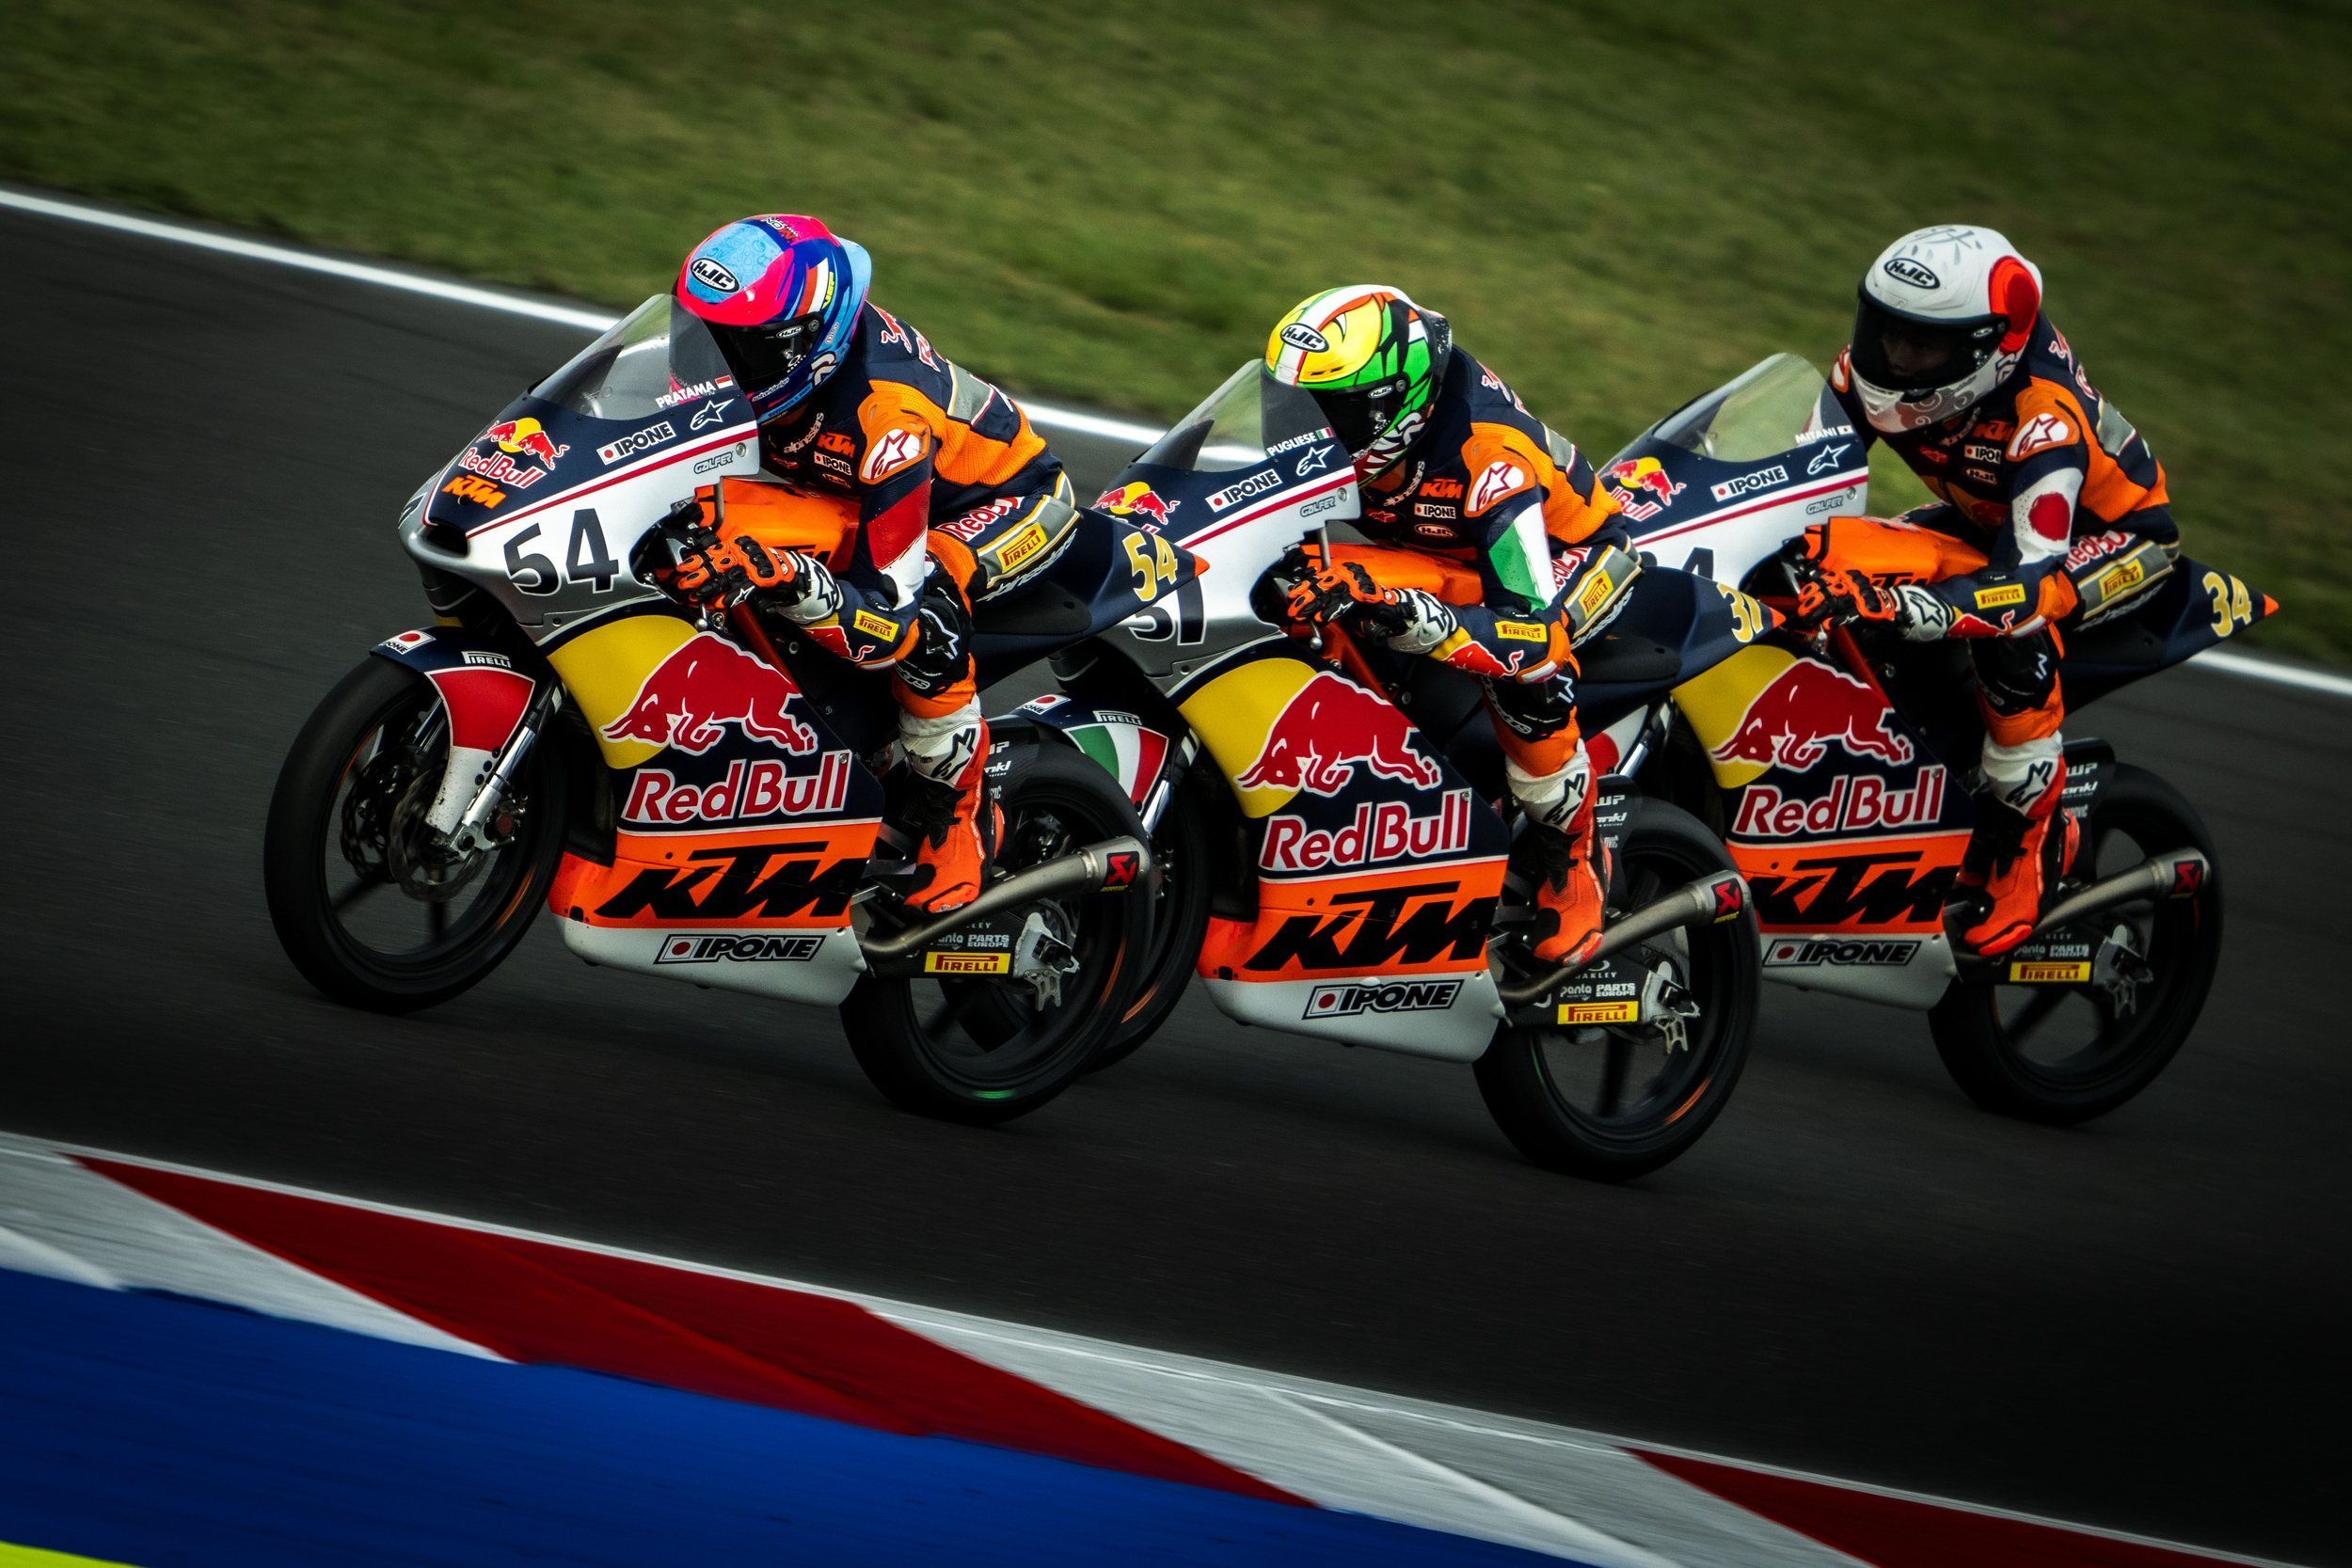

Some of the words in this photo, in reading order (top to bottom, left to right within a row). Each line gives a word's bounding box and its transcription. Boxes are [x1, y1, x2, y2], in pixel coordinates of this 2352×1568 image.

[692, 261, 734, 289] HJC
[1889, 261, 1935, 288] HJC
[1280, 325, 1325, 349] HJC
[656, 381, 716, 408] PRATAMA
[614, 423, 674, 456] IPONE
[817, 433, 856, 458] KTM
[1267, 433, 1316, 457] PUGLIESE
[1795, 427, 1837, 444] MITANI
[694, 451, 733, 474] GALFER
[822, 456, 851, 475] IPONE
[441, 474, 507, 509] KTM
[1223, 470, 1280, 503] IPONE
[1419, 478, 1464, 499] KTM
[1728, 468, 1786, 494] IPONE
[1300, 497, 1336, 517] GALFER
[1423, 506, 1455, 519] IPONE
[1806, 496, 1844, 515] GALFER
[503, 508, 619, 596] 54
[1002, 530, 1041, 567] PIRELLI
[1122, 531, 1178, 602] 54
[1582, 577, 1608, 613] PIRELLI
[1981, 589, 2021, 605] PIRELLI
[2202, 571, 2252, 637] 34
[1716, 582, 1763, 642] 31
[860, 615, 893, 637] PIRELLI
[1502, 624, 1541, 639] PIRELLI
[461, 651, 511, 669] PIRELLI
[1092, 710, 1143, 726] PIRELLI
[594, 841, 871, 919] KTM
[1747, 850, 1963, 926] KTM
[1242, 880, 1501, 971] KTM
[693, 937, 816, 958] IPONE
[968, 934, 1009, 942] PARTS
[935, 954, 999, 972] PIRELLI
[1798, 942, 1912, 965] IPONE
[2019, 964, 2080, 979] PIRELLI
[1339, 982, 1455, 1009] IPONE
[1596, 983, 1636, 991] PARTS
[1567, 1004, 1628, 1022] PIRELLI
